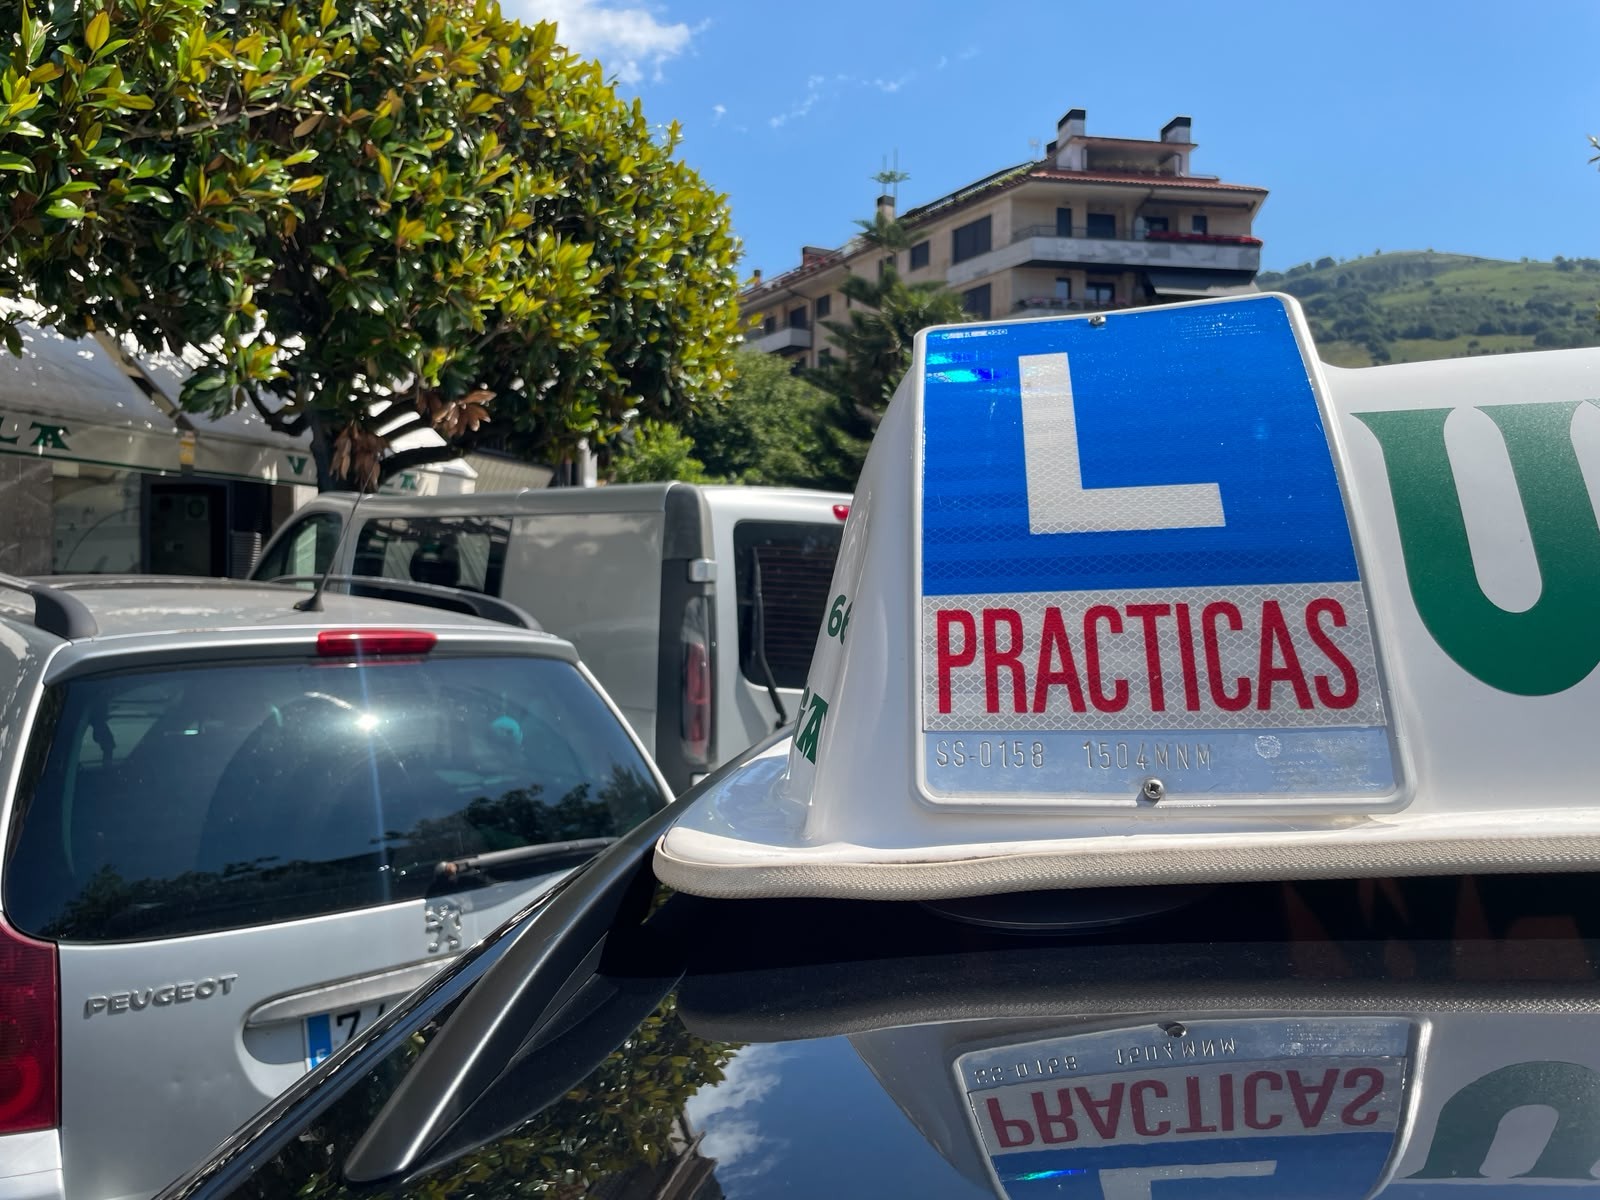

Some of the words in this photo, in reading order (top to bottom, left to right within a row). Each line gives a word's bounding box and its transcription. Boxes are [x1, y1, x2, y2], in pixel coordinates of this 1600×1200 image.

[1018, 352, 1226, 535] L
[935, 598, 1360, 715] PRACTICAS
[935, 739, 1045, 769] SS-0158
[1082, 741, 1214, 771] 1504MNM
[83, 973, 238, 1019] PEUGEOT
